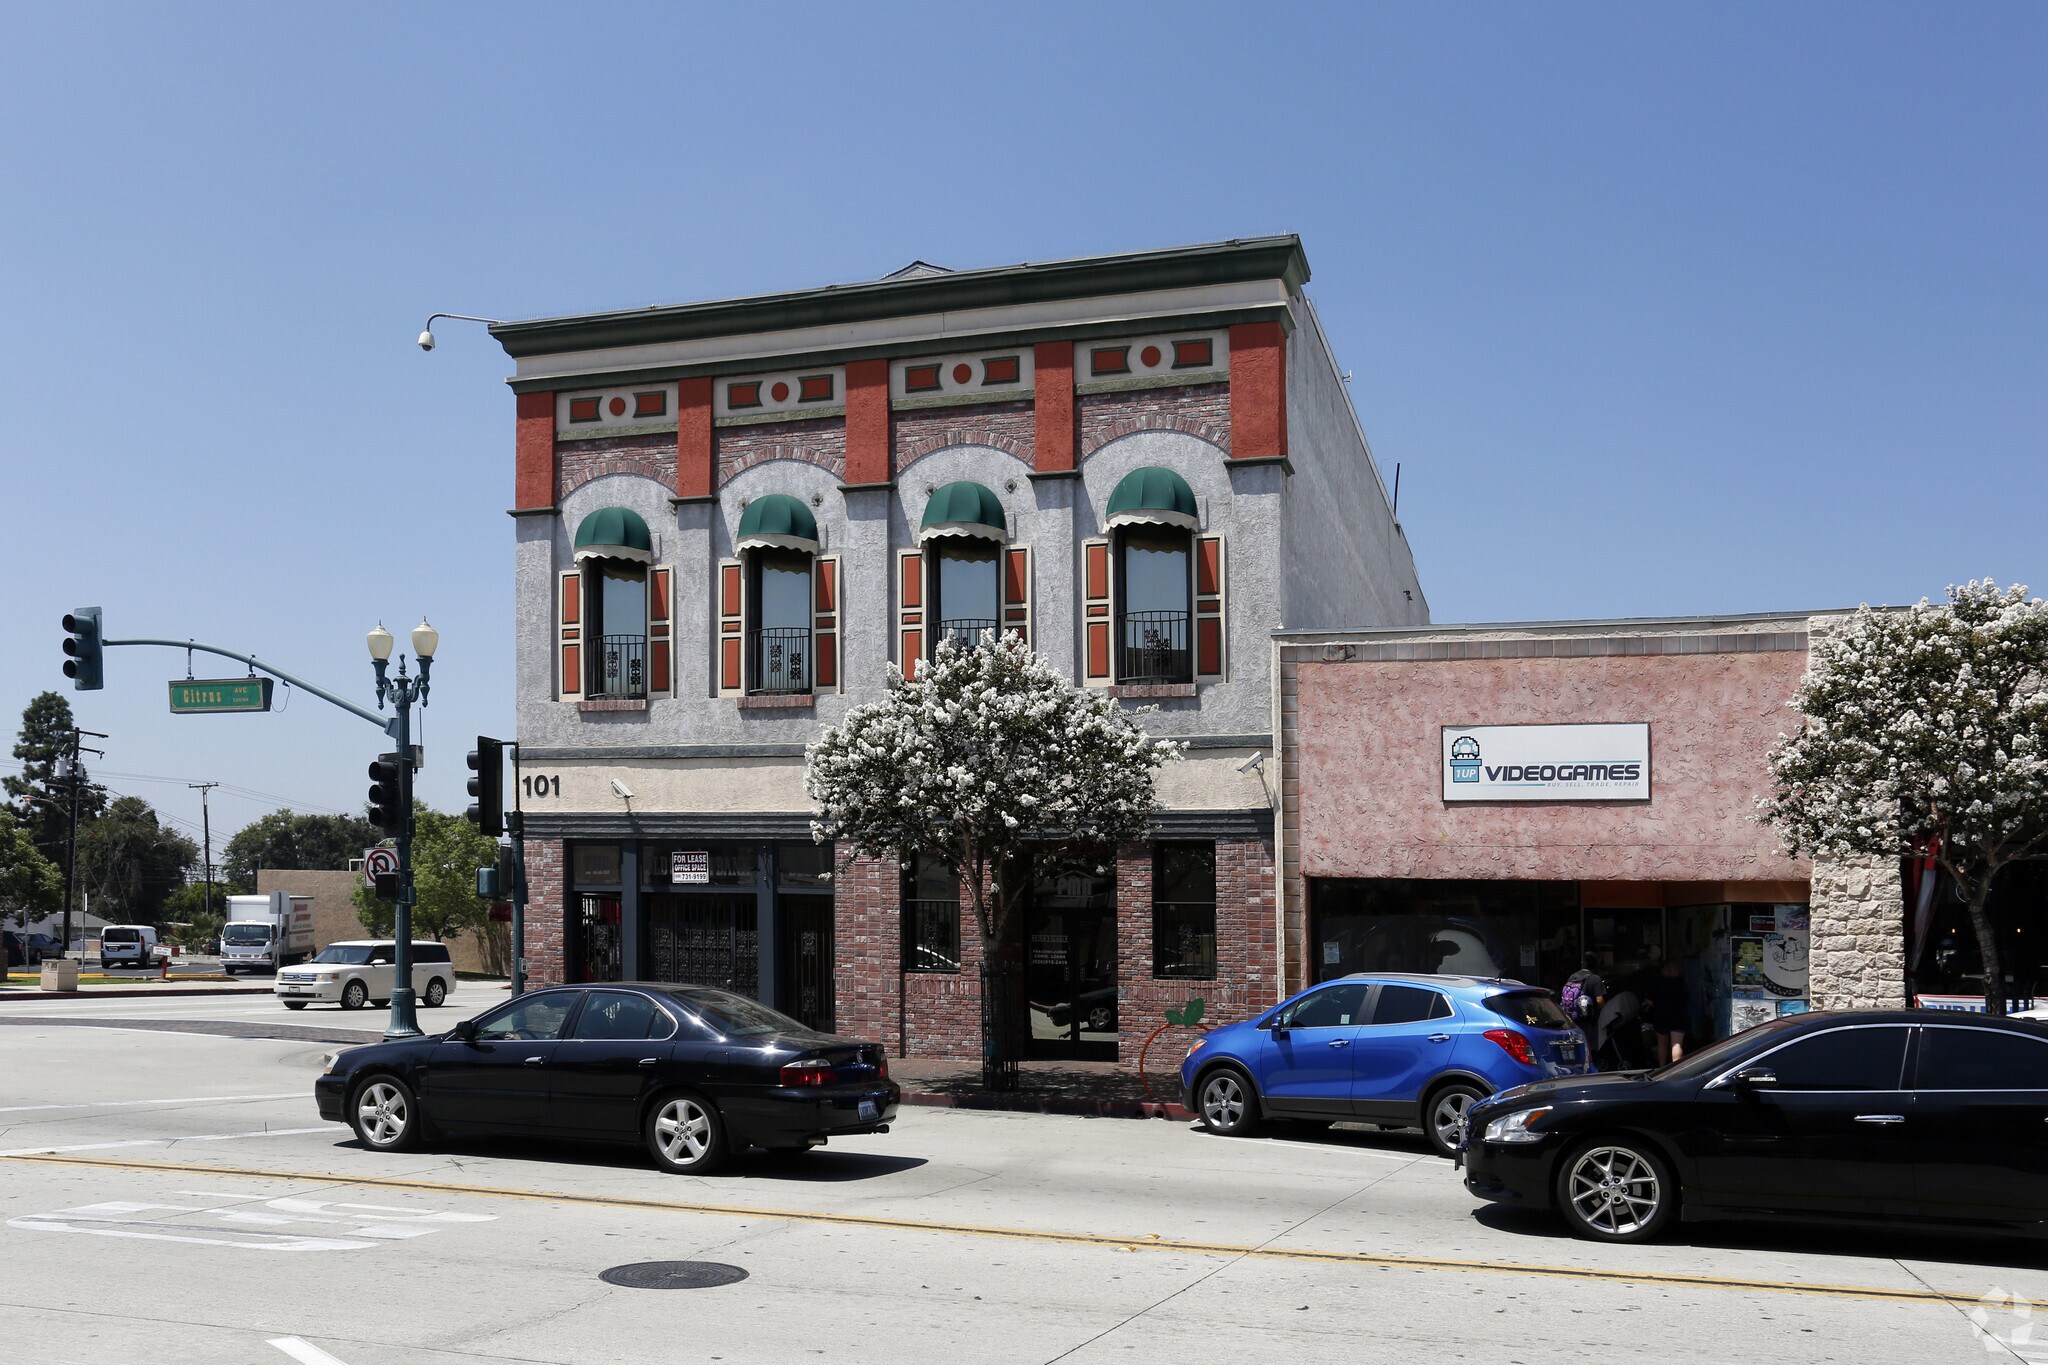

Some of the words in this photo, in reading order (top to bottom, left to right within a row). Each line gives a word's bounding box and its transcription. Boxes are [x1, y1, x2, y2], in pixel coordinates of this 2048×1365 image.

[183, 689, 222, 703] Citrus
[1455, 768, 1477, 779] 1UP
[1485, 764, 1641, 782] VIDEOGAMES
[522, 774, 560, 797] 101
[673, 854, 686, 863] FOR
[687, 854, 707, 863] LEASE
[674, 863, 691, 872] OFFICE
[692, 863, 707, 872] SPACE
